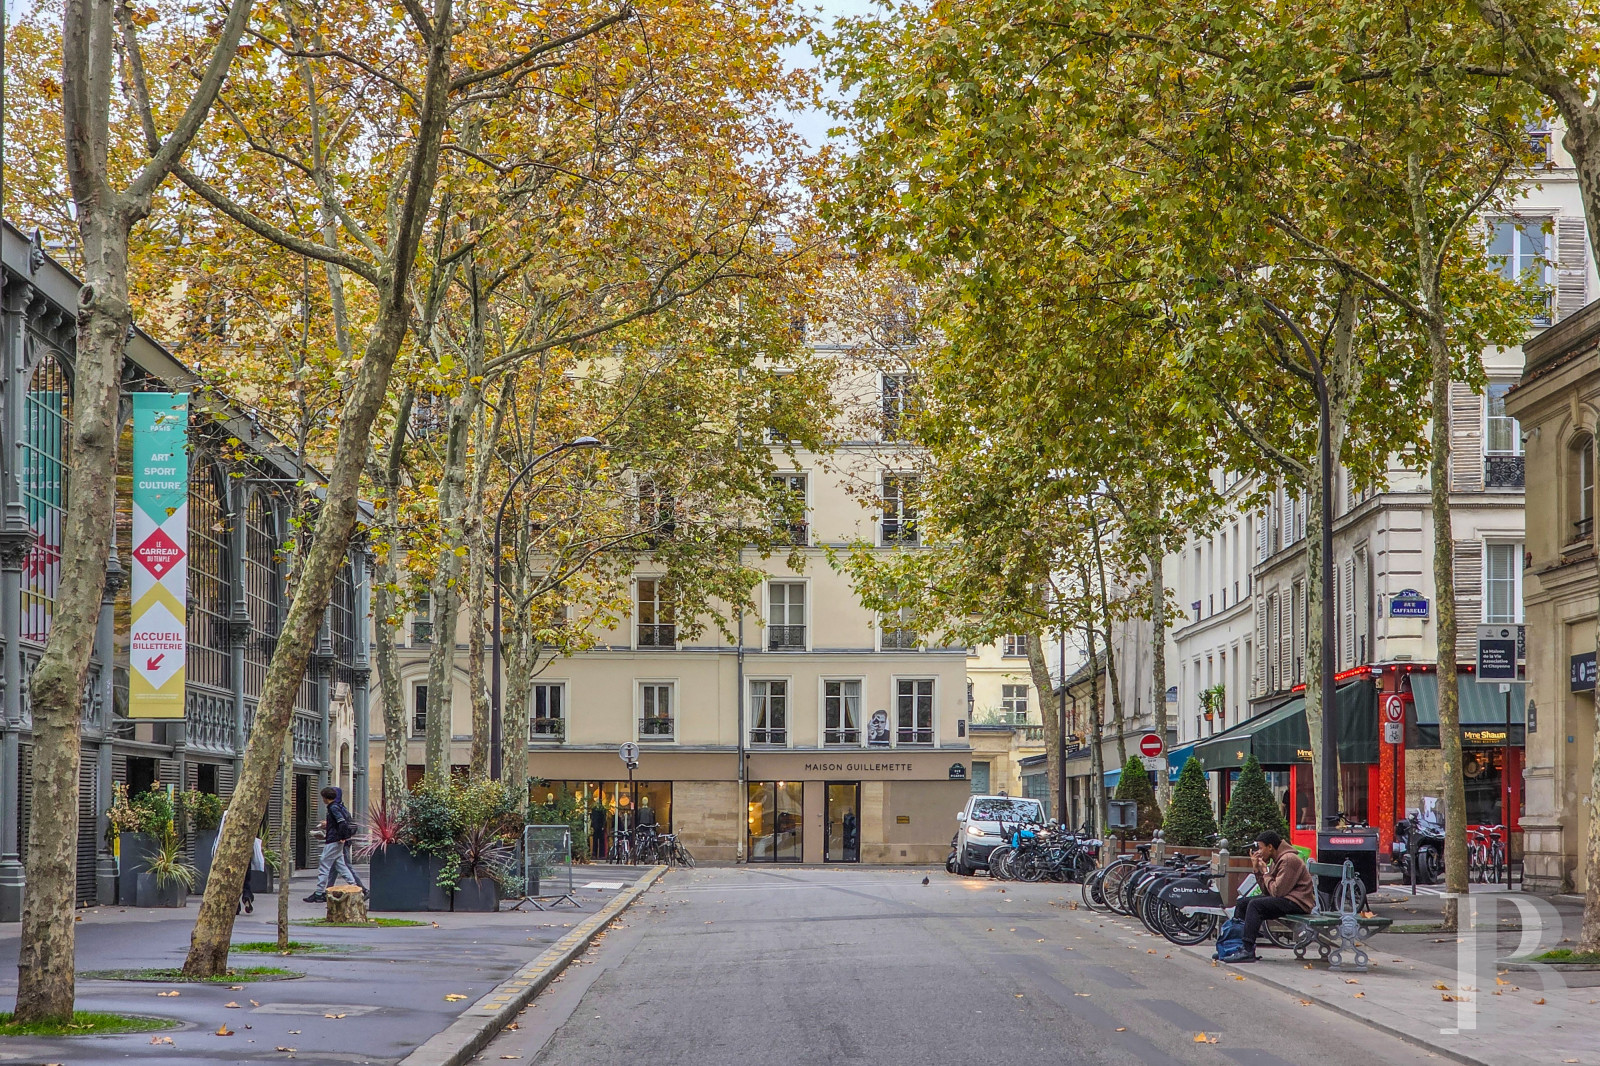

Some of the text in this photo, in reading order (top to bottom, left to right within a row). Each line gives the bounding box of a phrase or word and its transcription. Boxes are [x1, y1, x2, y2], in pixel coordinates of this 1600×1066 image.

[144, 468, 176, 476] SPORT
[139, 482, 181, 490] CULTURE
[134, 632, 182, 641] ACCUEIL
